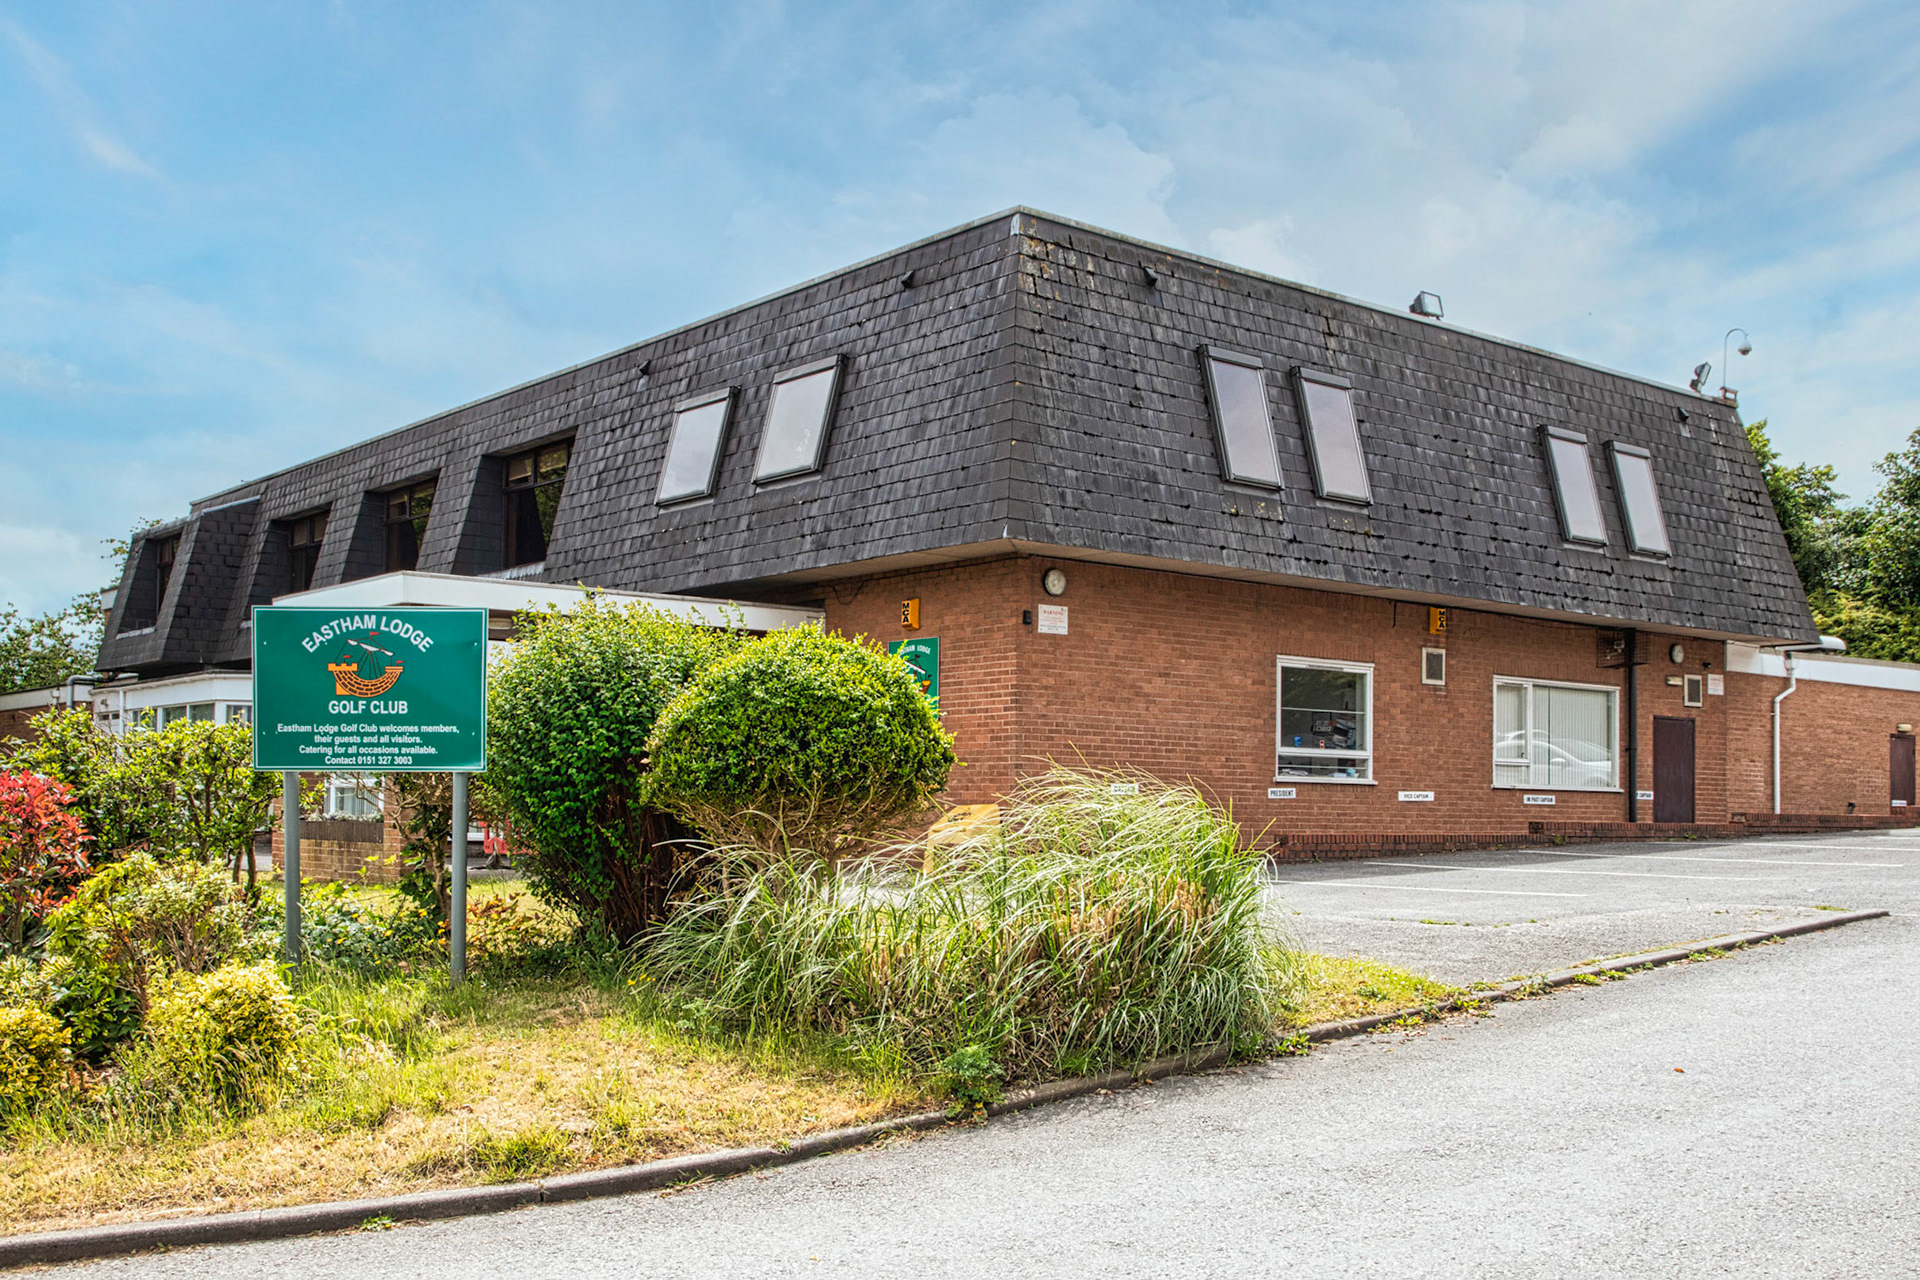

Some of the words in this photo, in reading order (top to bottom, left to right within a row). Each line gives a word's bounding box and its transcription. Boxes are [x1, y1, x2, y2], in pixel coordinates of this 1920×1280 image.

[902, 602, 910, 624] MCA
[1438, 610, 1446, 629] MCA
[301, 614, 376, 653] EASTHAM
[380, 616, 434, 652] LODGE
[328, 700, 367, 714] GOLF
[370, 700, 408, 714] CLUB
[277, 723, 312, 733] Eastham
[313, 723, 339, 735] Lodge
[340, 723, 358, 733] Golf
[359, 723, 378, 733] Club
[379, 723, 419, 733] welcomes
[420, 724, 460, 734] members,
[314, 735, 333, 743] their
[334, 736, 361, 745] guests
[362, 735, 378, 743] and
[379, 735, 390, 743] all
[390, 735, 423, 744] visitors.
[299, 745, 333, 756] Catering
[334, 745, 346, 754] for
[347, 745, 358, 754] all
[358, 745, 400, 754] occasions
[400, 745, 439, 754] available.
[324, 756, 357, 765] Contact
[357, 756, 376, 765] 0151
[377, 756, 393, 765] 327
[393, 756, 413, 765] 3003
